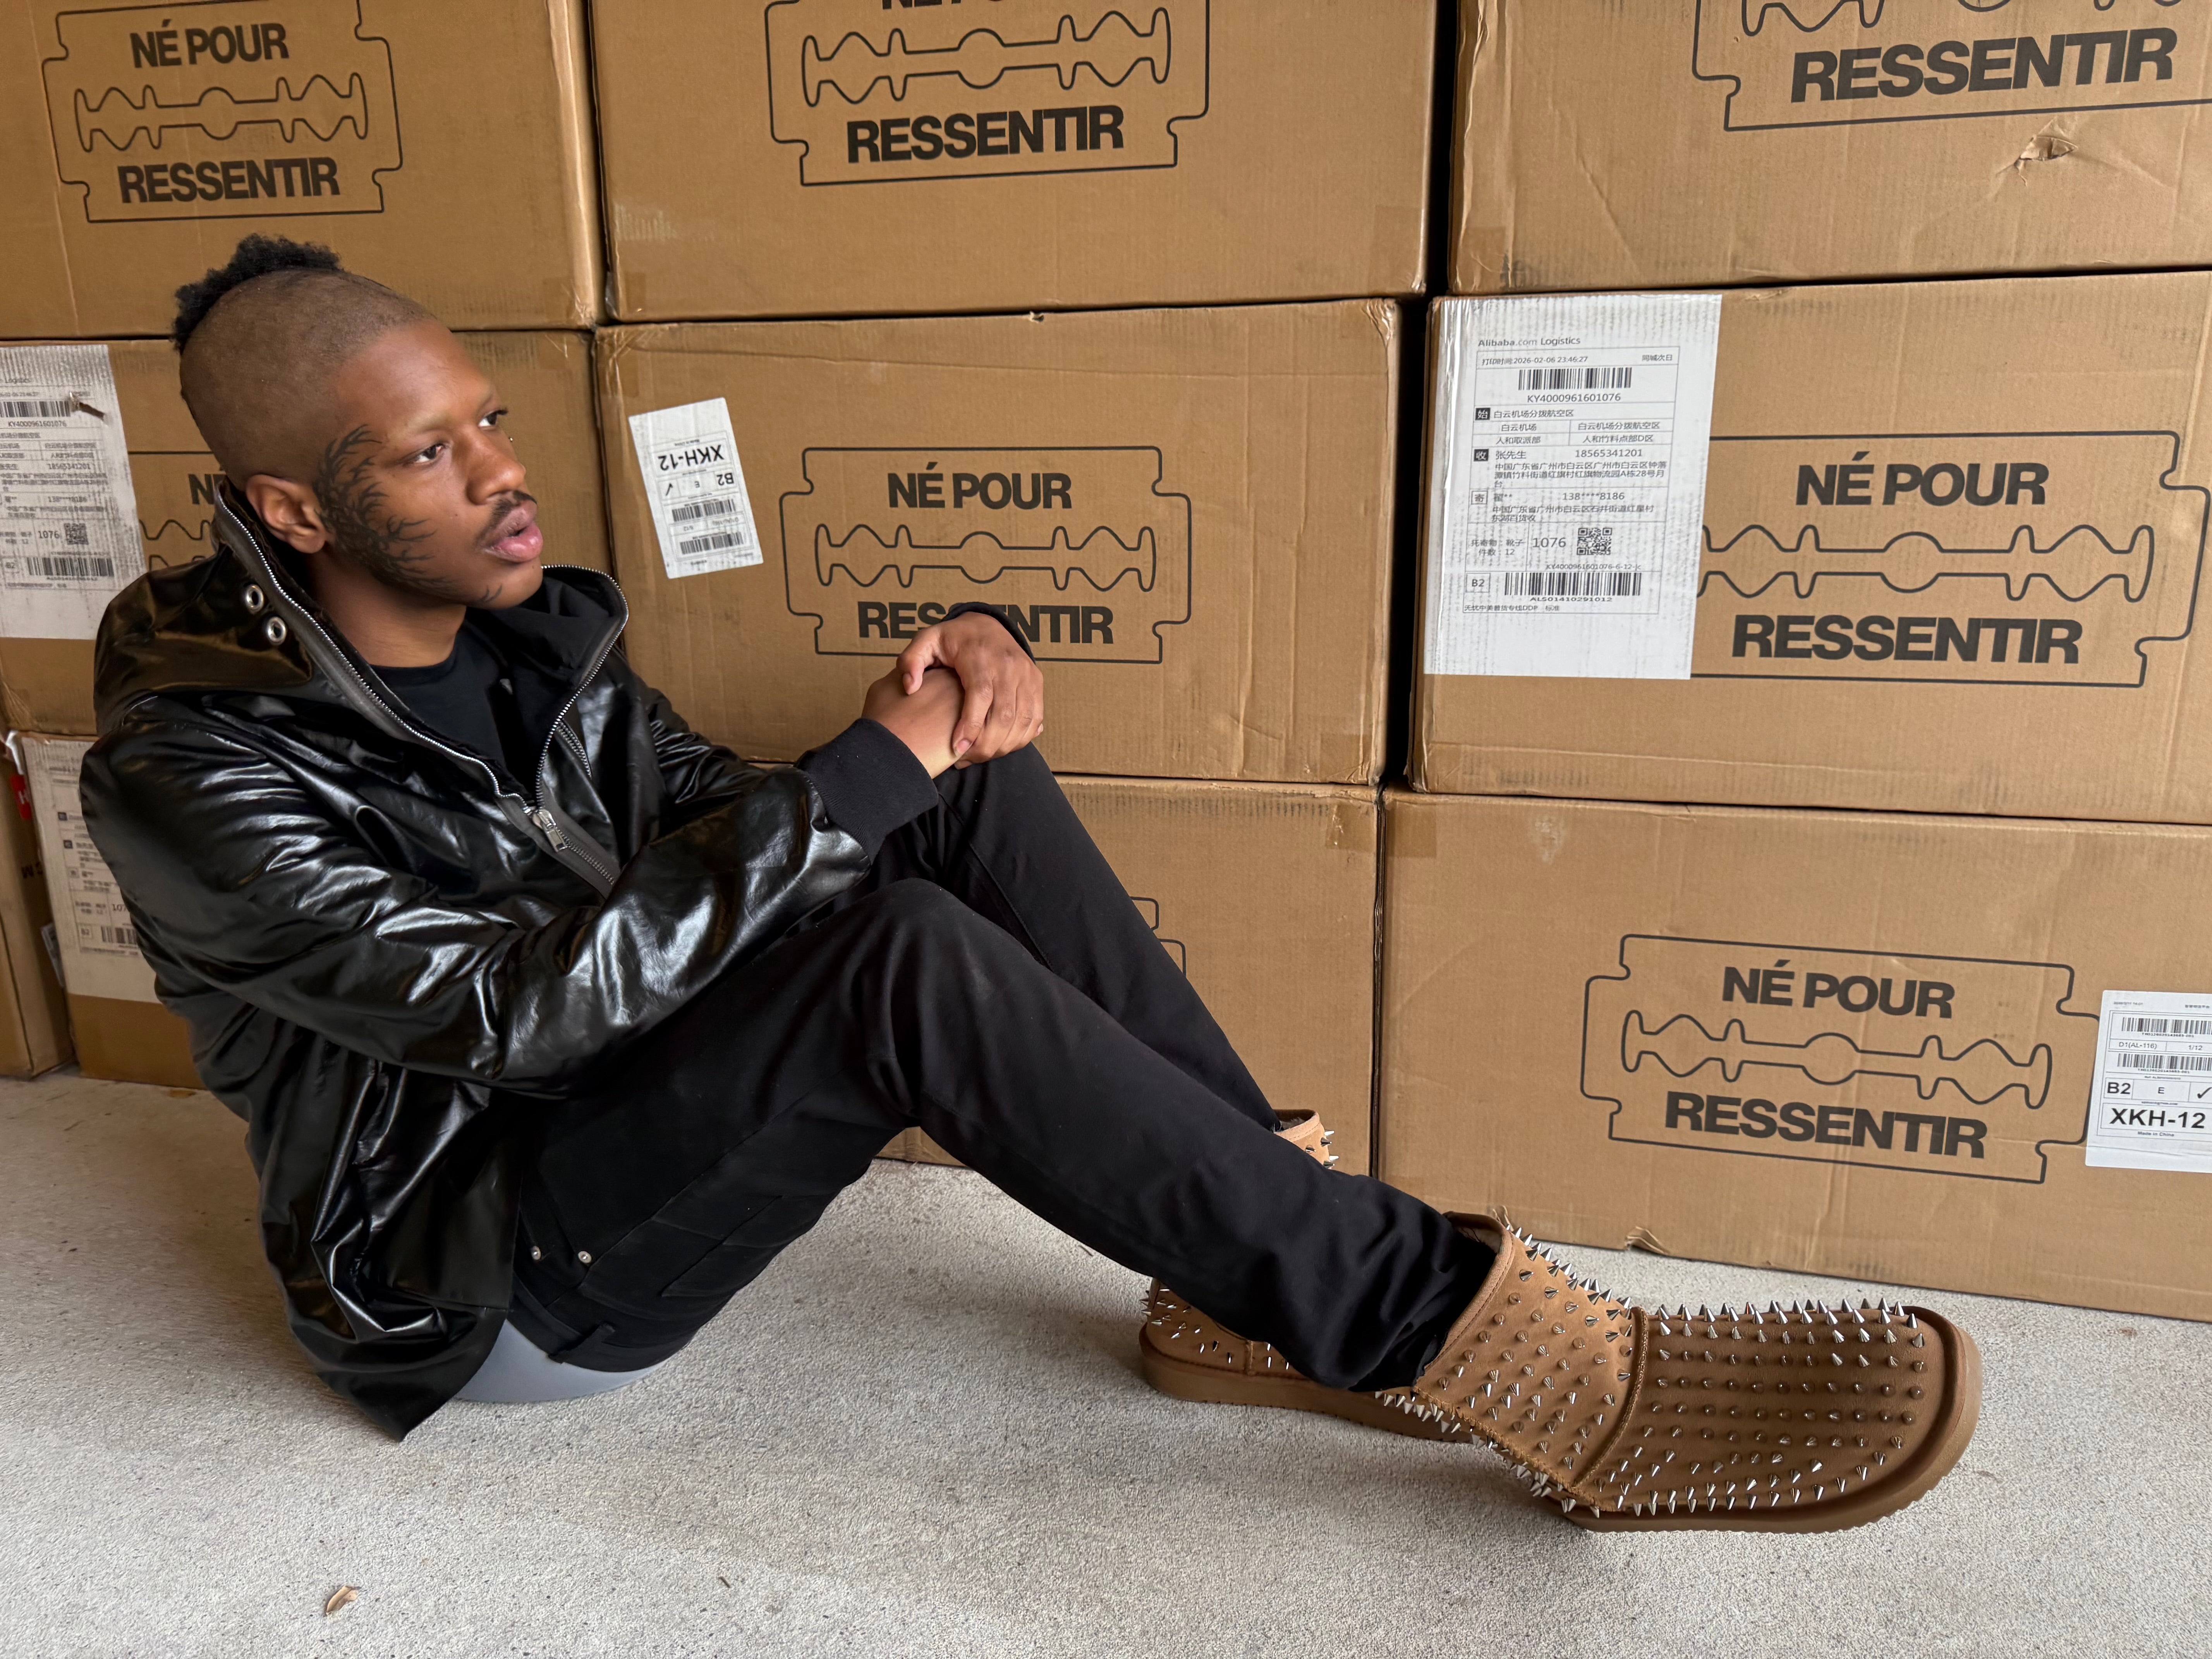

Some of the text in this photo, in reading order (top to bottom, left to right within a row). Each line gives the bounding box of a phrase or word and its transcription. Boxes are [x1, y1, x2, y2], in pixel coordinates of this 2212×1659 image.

[130, 19, 289, 68] NÉ POUR
[1791, 27, 2178, 103] RESSENTIR
[847, 105, 1124, 163] RESSENTIR
[117, 157, 340, 203] RESSENTIR
[1540, 337, 1581, 346] Logistics
[1527, 393, 1621, 403] KY4000961601076
[1477, 410, 1488, 419] 始
[1501, 424, 1537, 432] 白云机场
[658, 445, 725, 471] XKH-12
[1476, 450, 1527, 460] 收 张先生
[1575, 449, 1642, 458] 18565341201
[188, 474, 226, 505] N
[716, 472, 734, 486] B2
[887, 462, 1072, 510] NÉ POUR
[1796, 452, 2049, 507] NÉ POUR
[38, 531, 59, 539] 1076
[1532, 538, 1566, 548] 1076
[857, 601, 1114, 644] RESNTIR
[1732, 614, 2083, 664] RESSENTIR
[1722, 959, 1955, 1018] NÉ POUR
[2107, 1082, 2131, 1094] B2
[1665, 1091, 1988, 1159] RESSENTIR
[2109, 1108, 2206, 1129] XKH-12
